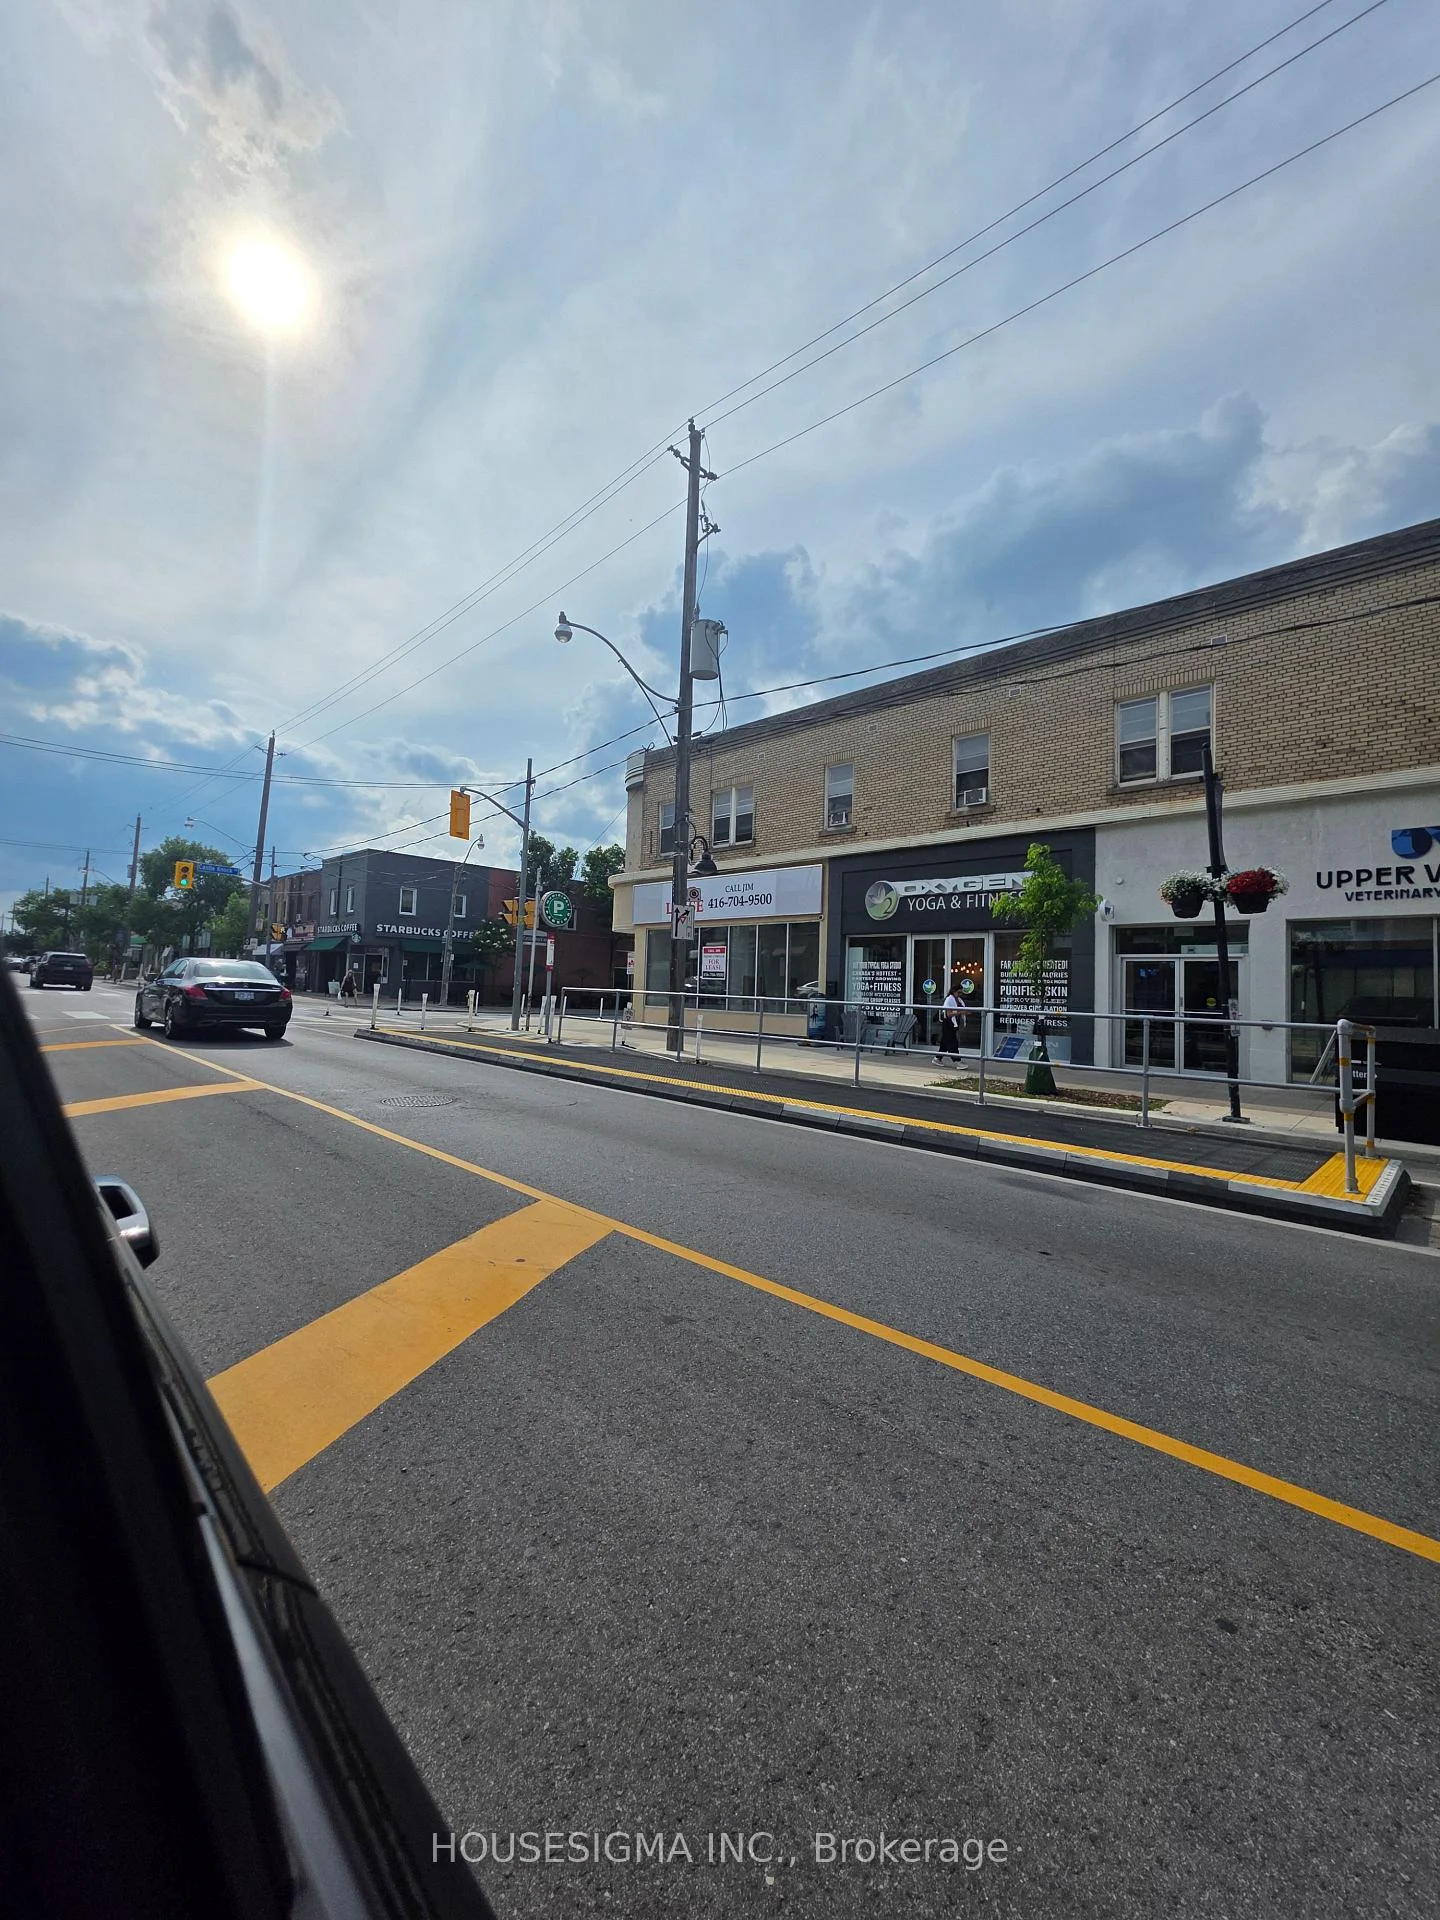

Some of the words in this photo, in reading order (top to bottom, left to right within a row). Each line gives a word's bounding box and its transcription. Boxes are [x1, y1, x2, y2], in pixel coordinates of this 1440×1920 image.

[1316, 866, 1415, 889] UPPER
[725, 885, 742, 893] CALL
[742, 883, 754, 892] JIM
[1345, 887, 1440, 902] VETERINARY
[553, 900, 565, 914] P
[708, 893, 772, 909] 416-704-9500
[907, 896, 946, 912] YOGA
[950, 895, 961, 910] &
[317, 924, 340, 934] STARBUCKS
[341, 923, 358, 932] COFFEE
[376, 923, 441, 937] STARBUCKS
[443, 929, 475, 940] COFFE
[1000, 985, 1042, 996] PURIFIES
[1044, 986, 1068, 997] SKIN
[1000, 1017, 1036, 1026] REDUCES
